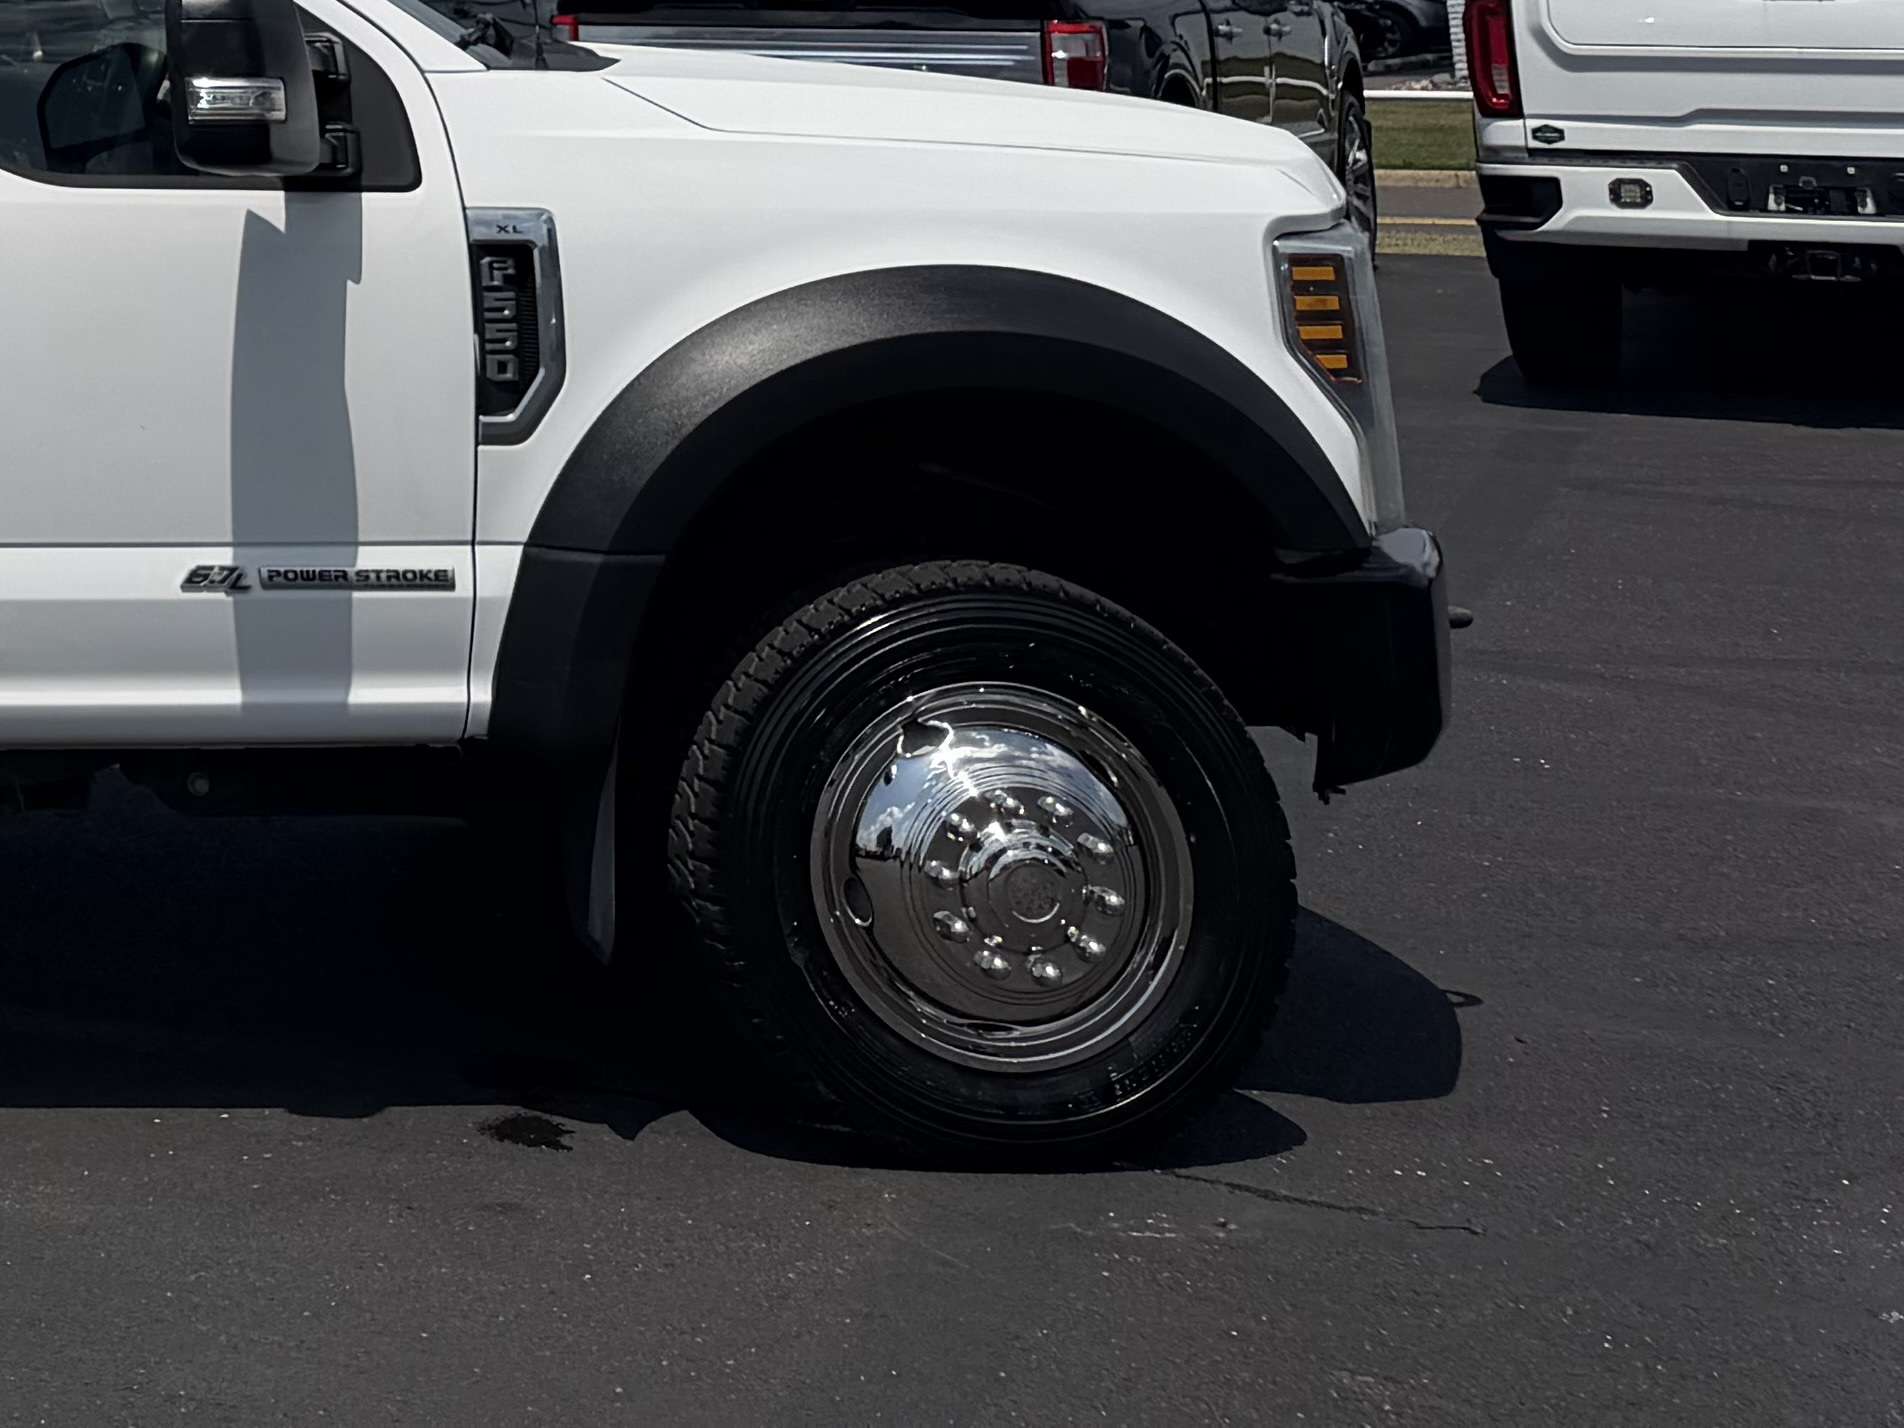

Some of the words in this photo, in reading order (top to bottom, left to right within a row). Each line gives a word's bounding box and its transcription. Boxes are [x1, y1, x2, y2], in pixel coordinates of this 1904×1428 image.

[496, 224, 523, 234] XL
[266, 568, 349, 584] POWER
[355, 568, 450, 583] STROKE
